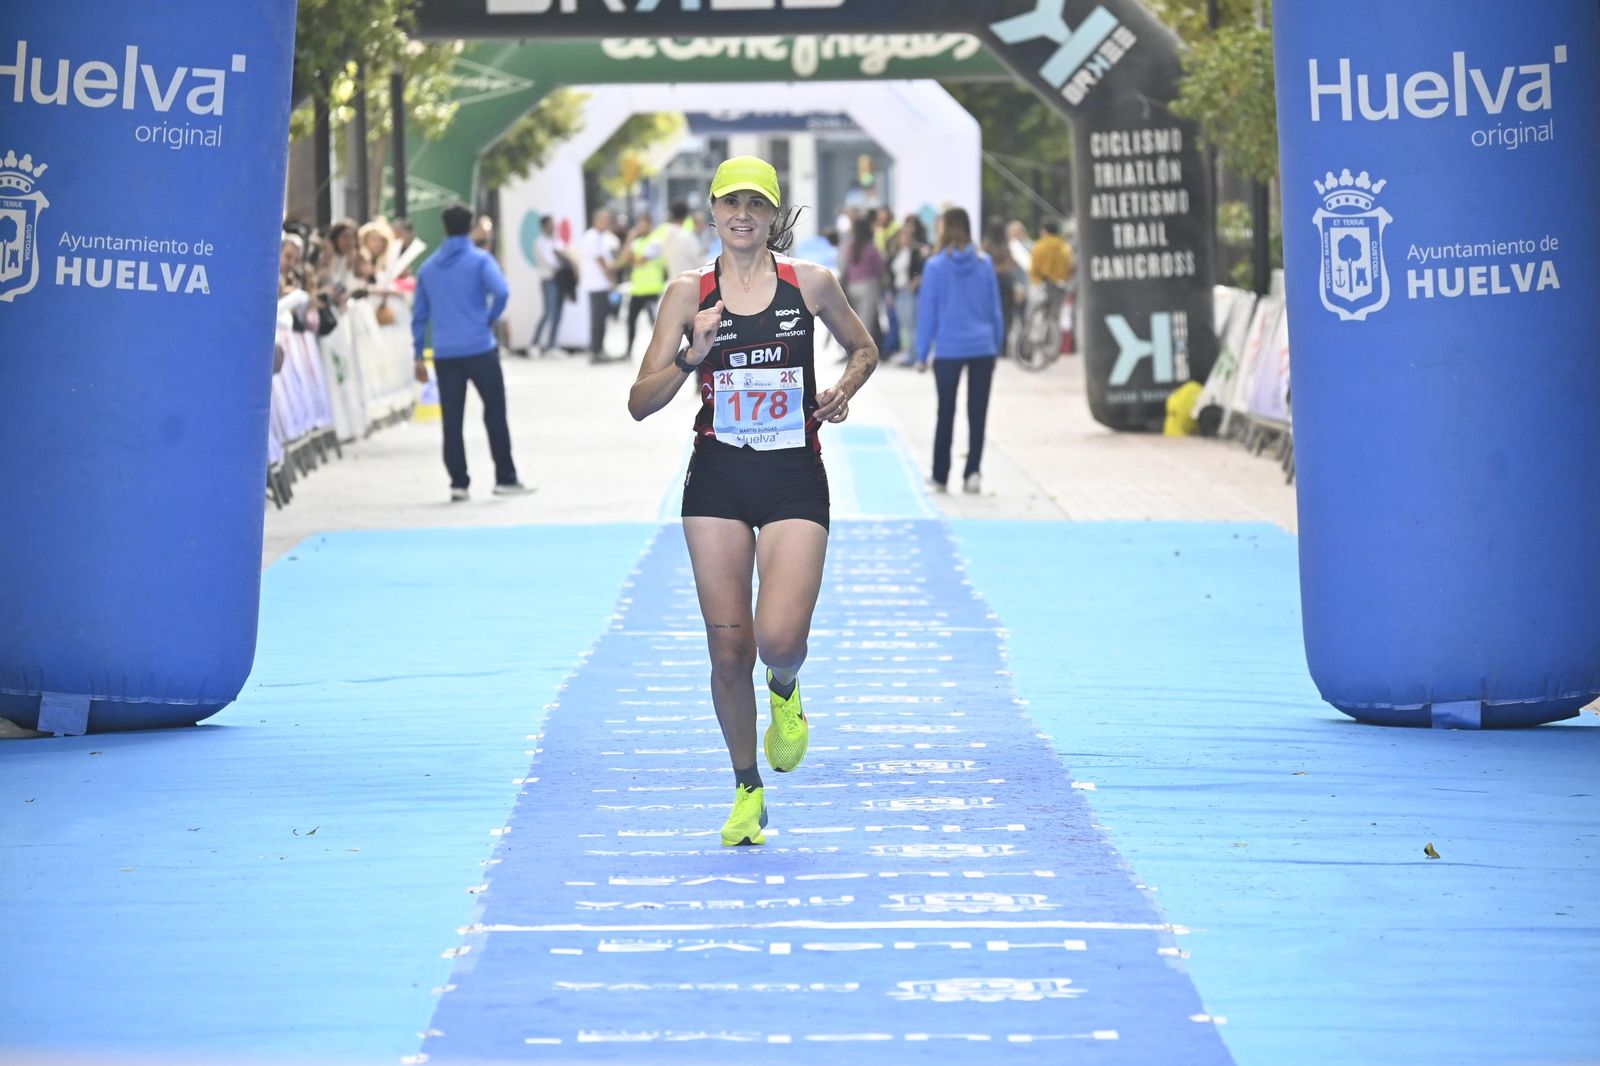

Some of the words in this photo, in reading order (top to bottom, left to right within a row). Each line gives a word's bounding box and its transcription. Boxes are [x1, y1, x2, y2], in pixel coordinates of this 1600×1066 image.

[0, 41, 226, 116] Huelva
[1309, 51, 1553, 122] Huelva
[135, 121, 222, 149] original
[1090, 128, 1182, 158] CICLISMO
[1471, 119, 1554, 150] original
[1094, 156, 1182, 188] TRIATLÓN
[1090, 189, 1190, 219] ATLETISMO
[58, 231, 189, 253] Ayuntamiento
[193, 240, 214, 256] de
[1113, 222, 1169, 249] TRAIL
[1407, 240, 1536, 264] Ayuntamiento
[1540, 234, 1559, 252] de
[55, 256, 211, 295] HUELVA
[1090, 251, 1196, 282] CANICROSS
[1407, 260, 1561, 299] HUELVA
[751, 347, 781, 364] BM
[719, 372, 734, 385] 2K
[780, 370, 797, 383] 2K
[728, 391, 788, 421] 178
